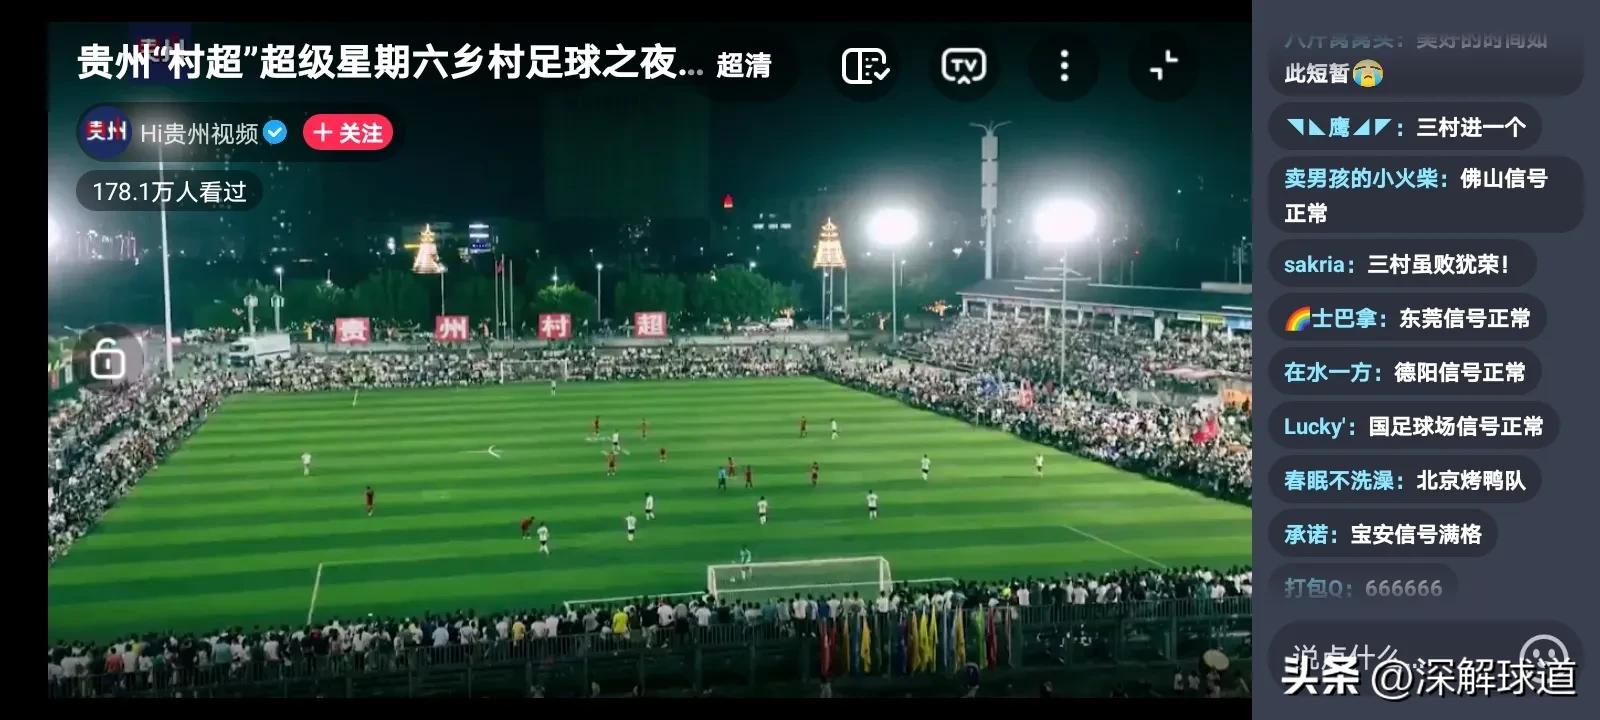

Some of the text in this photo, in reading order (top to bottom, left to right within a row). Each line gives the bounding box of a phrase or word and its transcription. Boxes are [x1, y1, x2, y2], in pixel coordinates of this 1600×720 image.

[440, 316, 467, 340] 州
[541, 315, 569, 338] 村
[637, 313, 665, 336] 超
